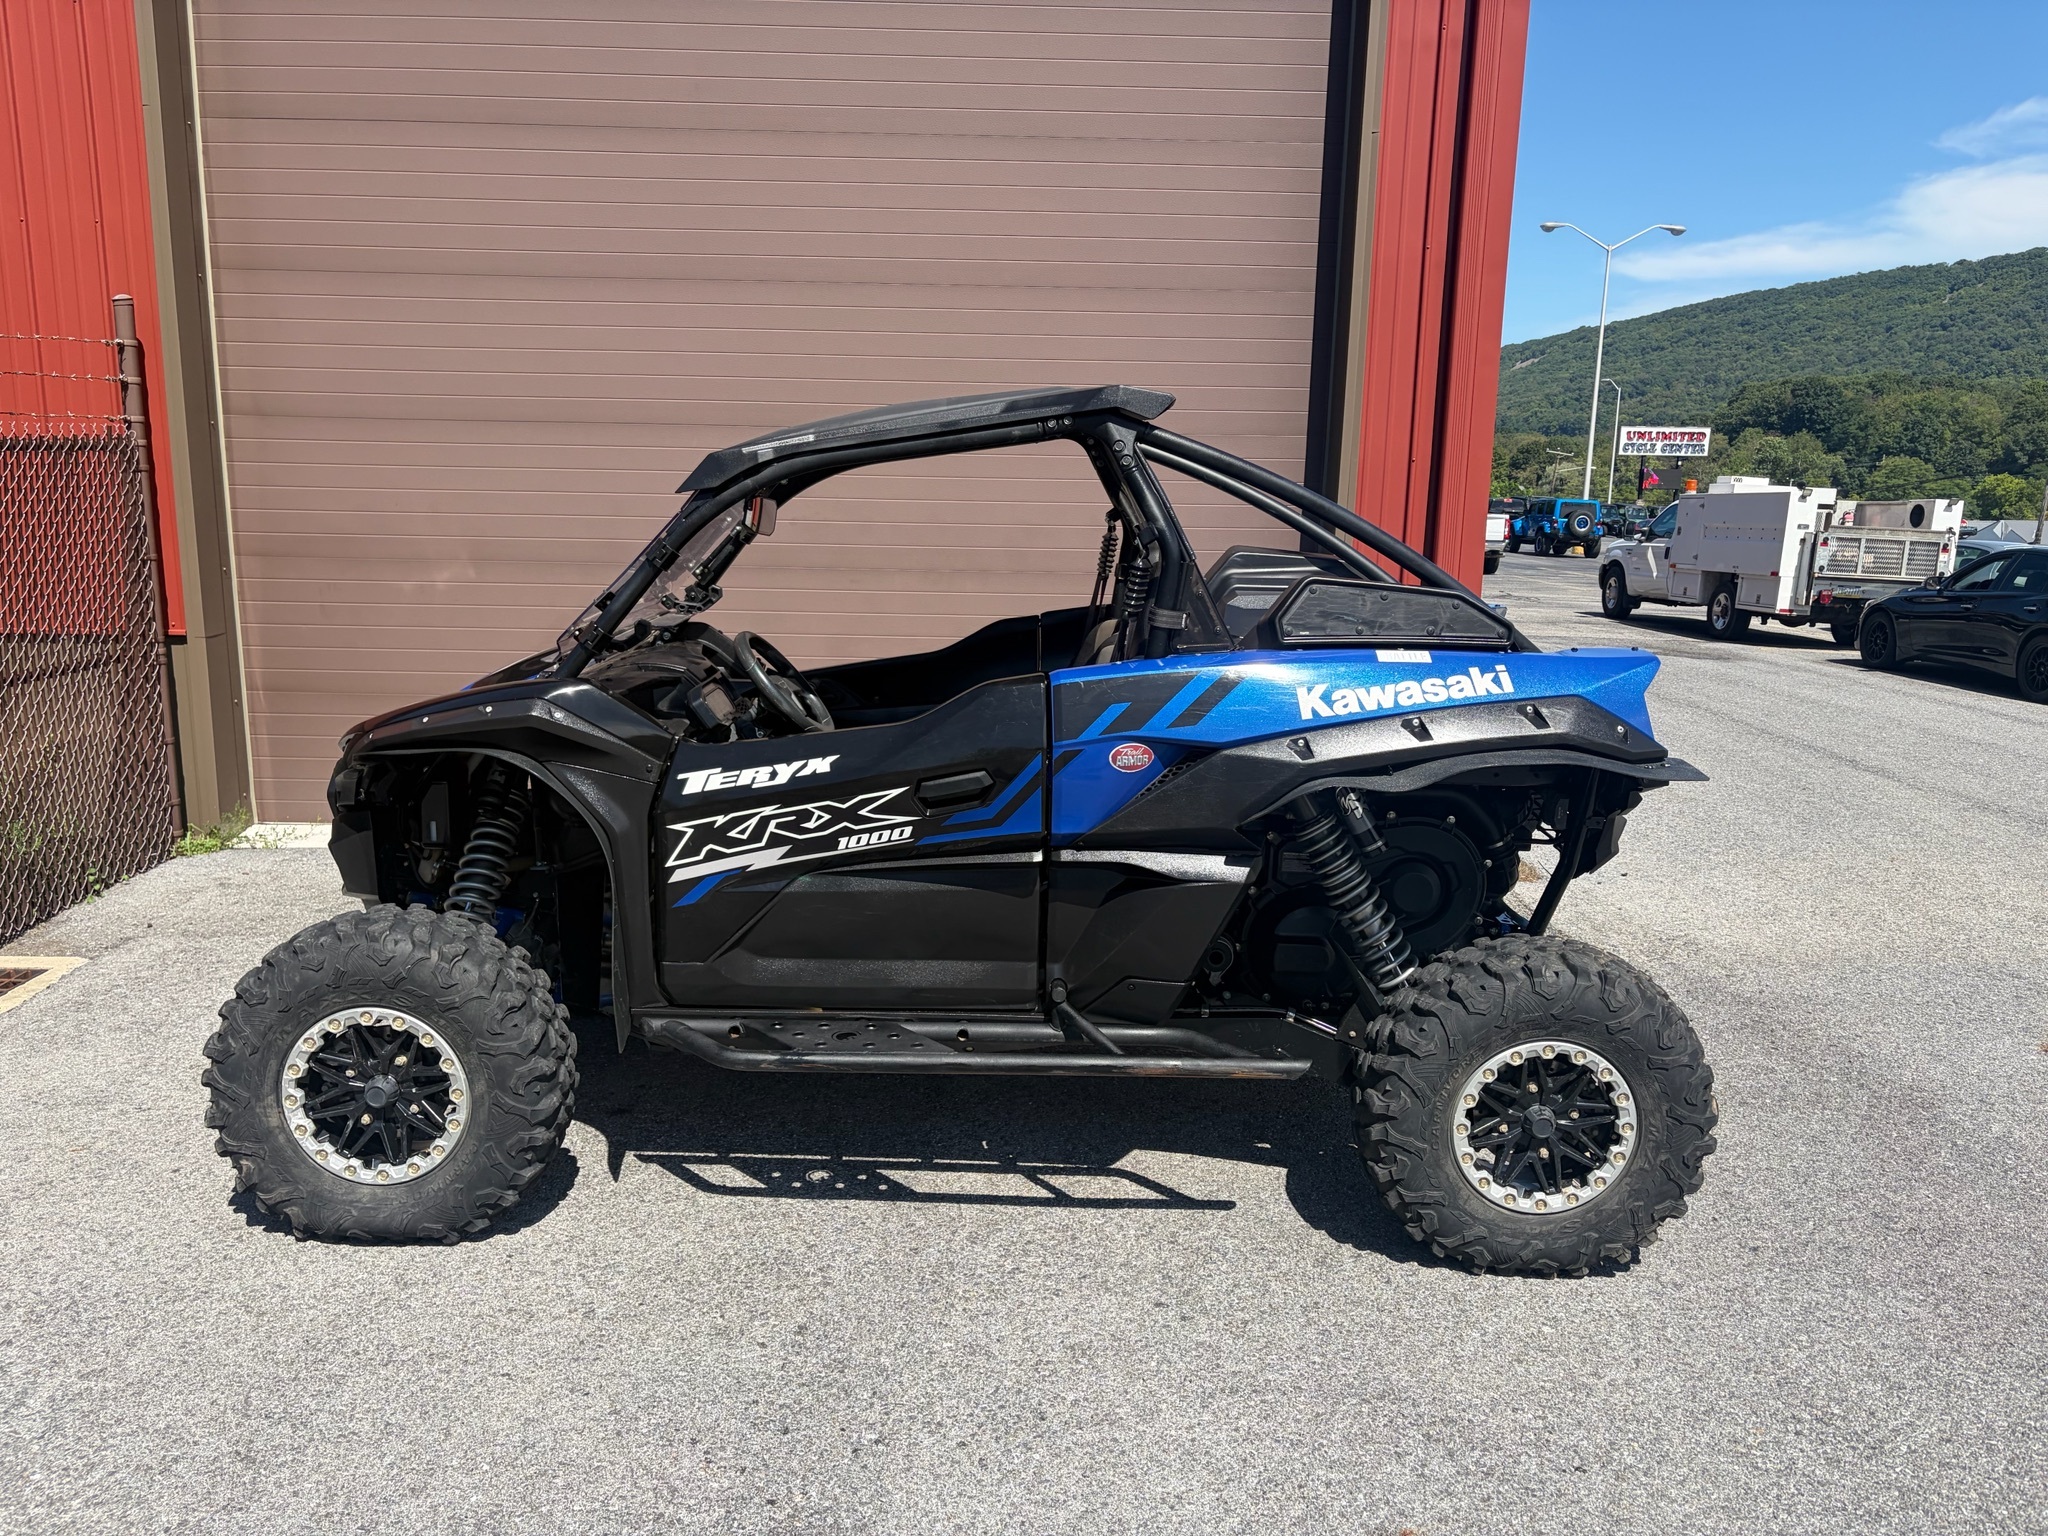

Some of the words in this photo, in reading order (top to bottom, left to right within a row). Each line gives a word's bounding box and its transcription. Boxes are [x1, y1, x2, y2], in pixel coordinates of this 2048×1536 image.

[1622, 442, 1657, 454] CYCLE
[1660, 443, 1706, 455] CENTER
[1626, 430, 1706, 442] UNLIMITED
[1296, 664, 1515, 720] Kawasaki
[1116, 754, 1149, 767] ARMOR
[1119, 747, 1145, 756] Trail
[677, 754, 841, 795] TERYX
[664, 786, 922, 867] KRX
[837, 825, 914, 850] 1000
[1430, 1050, 1484, 1152] CARNIVORE
